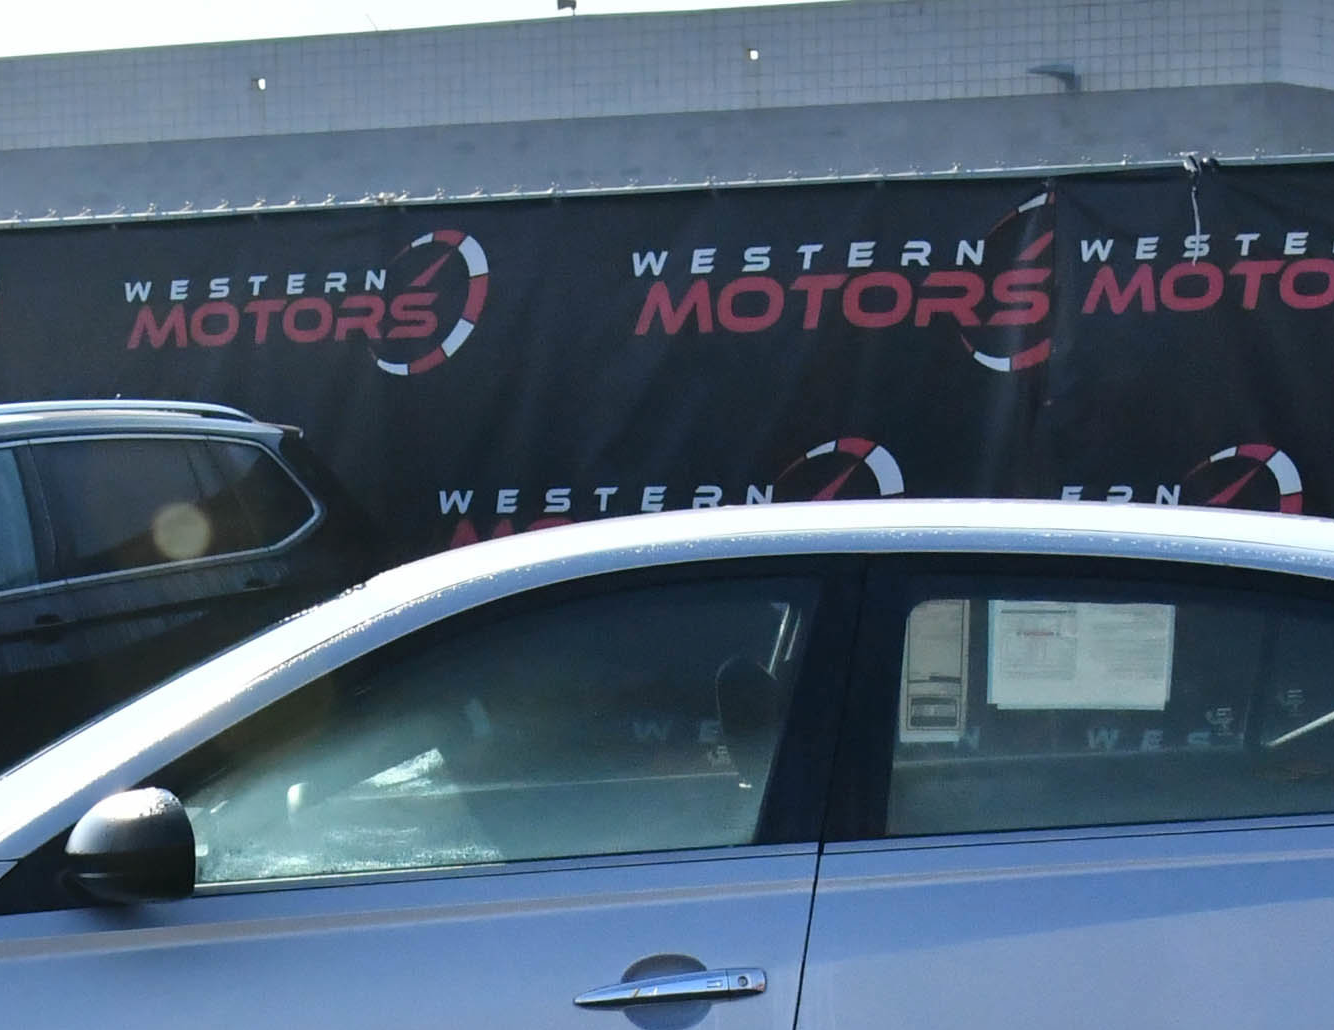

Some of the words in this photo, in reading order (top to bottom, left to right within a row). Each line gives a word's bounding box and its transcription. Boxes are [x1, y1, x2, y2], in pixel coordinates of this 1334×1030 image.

[631, 238, 986, 278] WESTERN
[123, 268, 388, 304] WESTERN
[634, 267, 1051, 336] MOTORS
[128, 292, 438, 348] MOTORS
[438, 484, 774, 514] WESTERN
